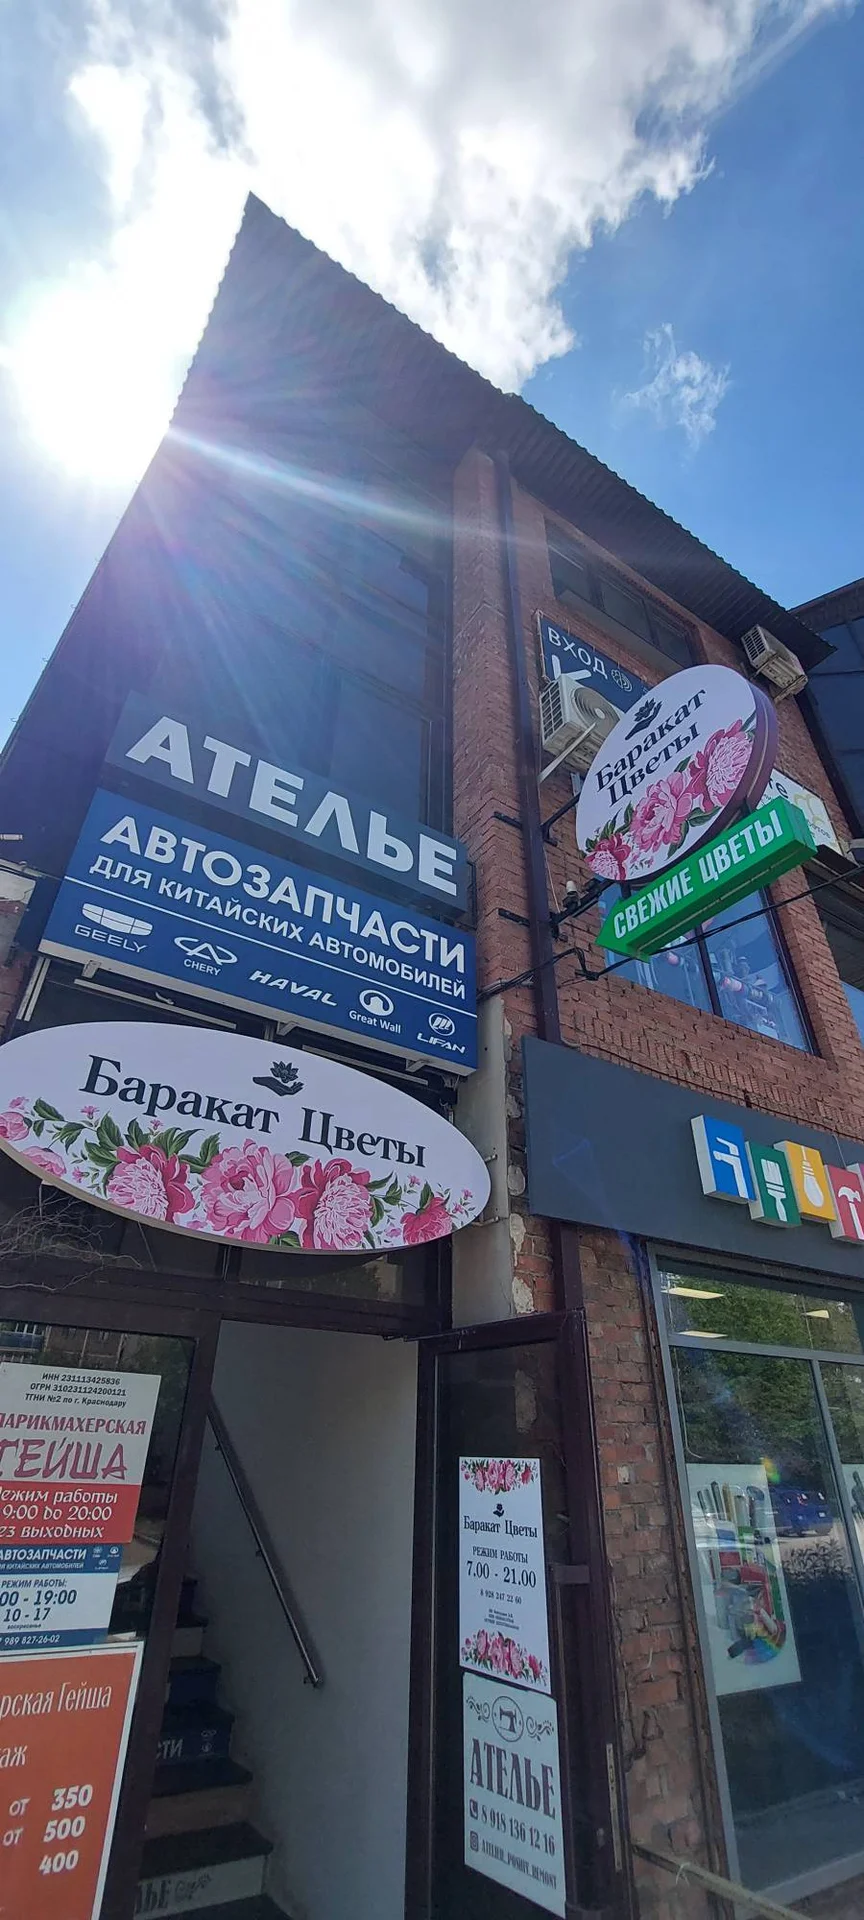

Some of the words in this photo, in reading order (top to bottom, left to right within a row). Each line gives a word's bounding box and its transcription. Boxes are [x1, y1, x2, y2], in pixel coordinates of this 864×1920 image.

[547, 626, 609, 680] ВХОД
[595, 689, 706, 793] Баракат
[607, 721, 701, 808] Цветы
[125, 715, 458, 897] АТЕЛЬЕ
[613, 867, 694, 940] СВЕЖИЕ
[698, 809, 783, 884] ЦВЕТЫ
[100, 814, 467, 974] АВТОЗАПЧАСТИ
[74, 923, 148, 954] GEELY
[88, 855, 152, 890] ДЛЯ
[158, 877, 304, 943] КИТАЙСКИХ
[308, 932, 466, 1000] АВТОМОБИЛЕЙ
[183, 958, 222, 977] CHERY
[249, 970, 339, 1007] HAVAL
[349, 1009, 378, 1027] Great
[379, 1018, 402, 1034] Wall
[416, 1032, 466, 1054] LIFAN
[79, 1054, 280, 1135] Баракат
[298, 1106, 427, 1168] Цветы
[30, 1383, 51, 1392] ОГРН
[52, 1384, 127, 1397] 310231124200121
[42, 1372, 60, 1382] ИНН
[61, 1374, 121, 1386] 231113425836
[47, 1395, 62, 1404] №2
[81, 1397, 127, 1409] Краснодару
[0, 1486, 49, 1503] ежим
[53, 1488, 118, 1505] работы
[2, 1504, 39, 1520] 9:00
[43, 1505, 63, 1520] до
[67, 1505, 112, 1521] 20:00
[20, 1523, 105, 1538] выходных
[463, 1515, 501, 1534] Баракат
[505, 1519, 538, 1539] Цветы
[472, 1545, 498, 1559] РЕЖИМ
[500, 1549, 529, 1564] РАБОТЫ
[1, 1580, 32, 1588] РЕЖИМ
[33, 1579, 68, 1588] РАБОТЫ:
[466, 1560, 490, 1580] 7.00
[503, 1566, 537, 1588] 21.00
[33, 1589, 78, 1606] 19:00
[3, 1608, 21, 1622] 10
[33, 1607, 51, 1621] 17
[4, 1637, 20, 1645] 989
[21, 1634, 61, 1644] 827-26-02
[57, 1681, 112, 1712] Гейша
[469, 1738, 556, 1821] АТЕЛЬЕ
[51, 1784, 94, 1812] 350
[43, 1815, 86, 1843] 500
[481, 1804, 488, 1825] 8
[489, 1808, 507, 1833] 918
[509, 1817, 526, 1843] 136
[529, 1827, 541, 1850] 12
[542, 1833, 556, 1857] 16
[38, 1849, 79, 1875] 400
